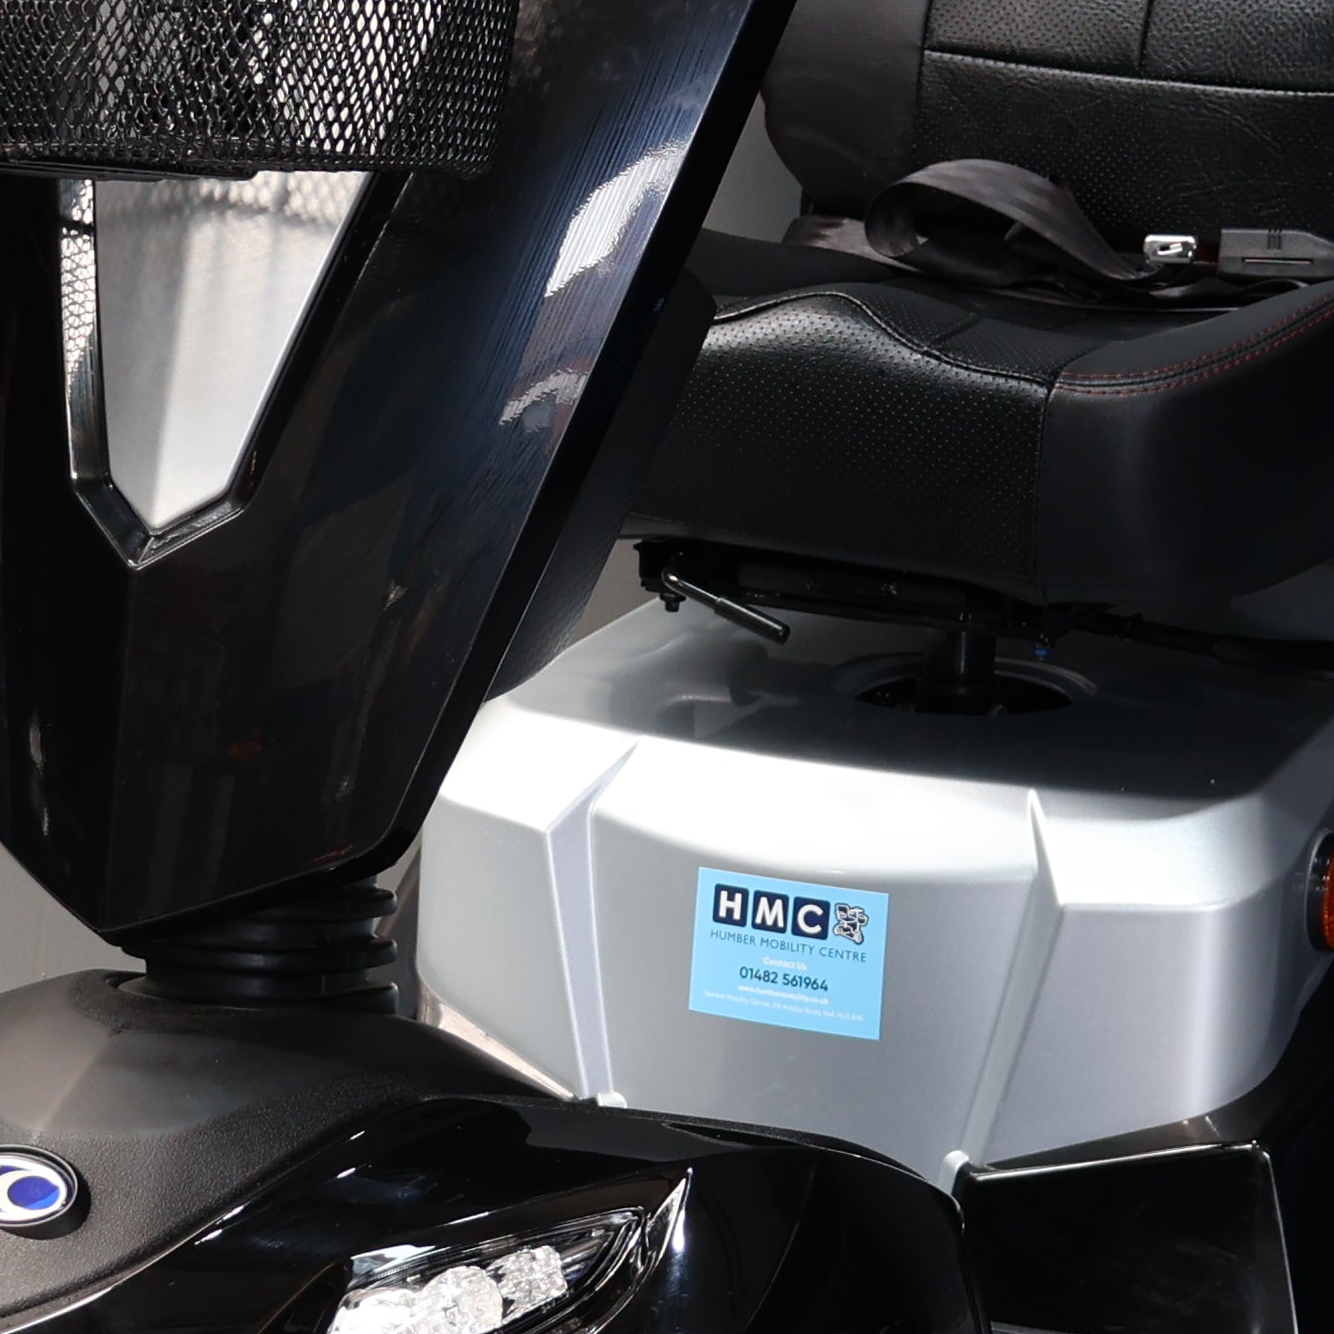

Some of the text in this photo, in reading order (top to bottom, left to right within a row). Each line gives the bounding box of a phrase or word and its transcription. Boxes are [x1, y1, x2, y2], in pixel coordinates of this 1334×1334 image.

[719, 889, 824, 935] HMC
[710, 929, 867, 963] HUMBER MOBILITY CENTRE
[739, 965, 829, 992] 01482 561964
[763, 956, 808, 971] Contact Us
